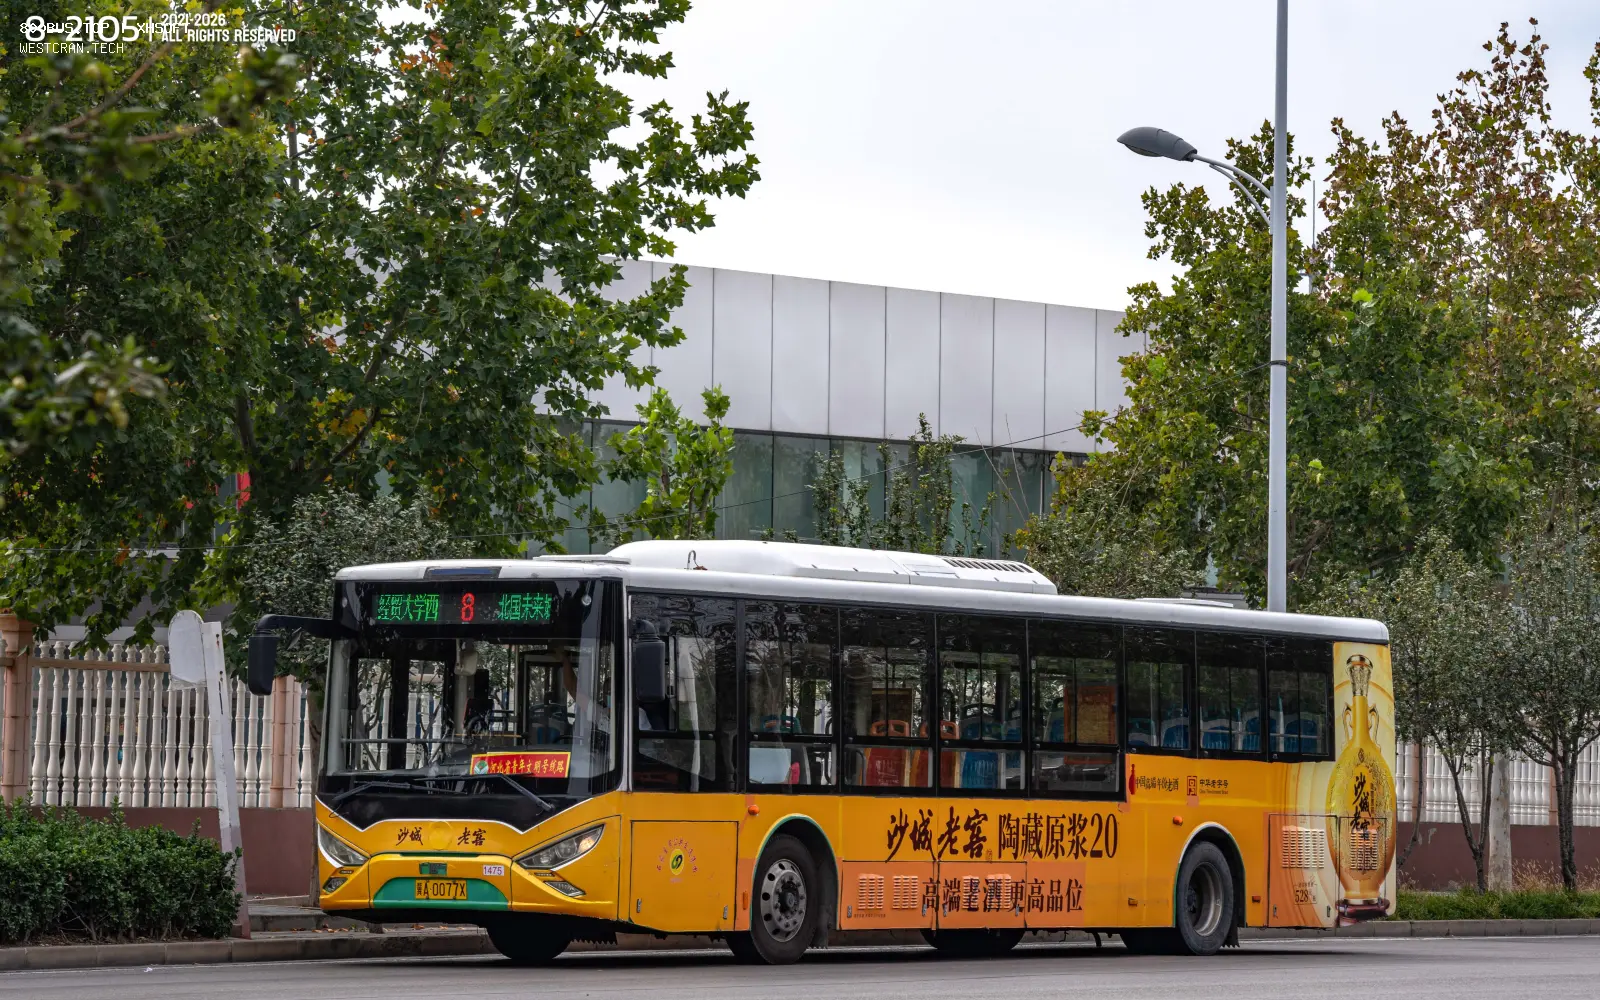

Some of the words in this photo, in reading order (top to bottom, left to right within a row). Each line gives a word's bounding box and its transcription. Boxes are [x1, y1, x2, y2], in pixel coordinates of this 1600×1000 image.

[461, 592, 475, 622] 8
[997, 812, 1119, 861] 陶藏原浆20
[483, 866, 502, 876] 1475
[1295, 889, 1309, 903] 528
